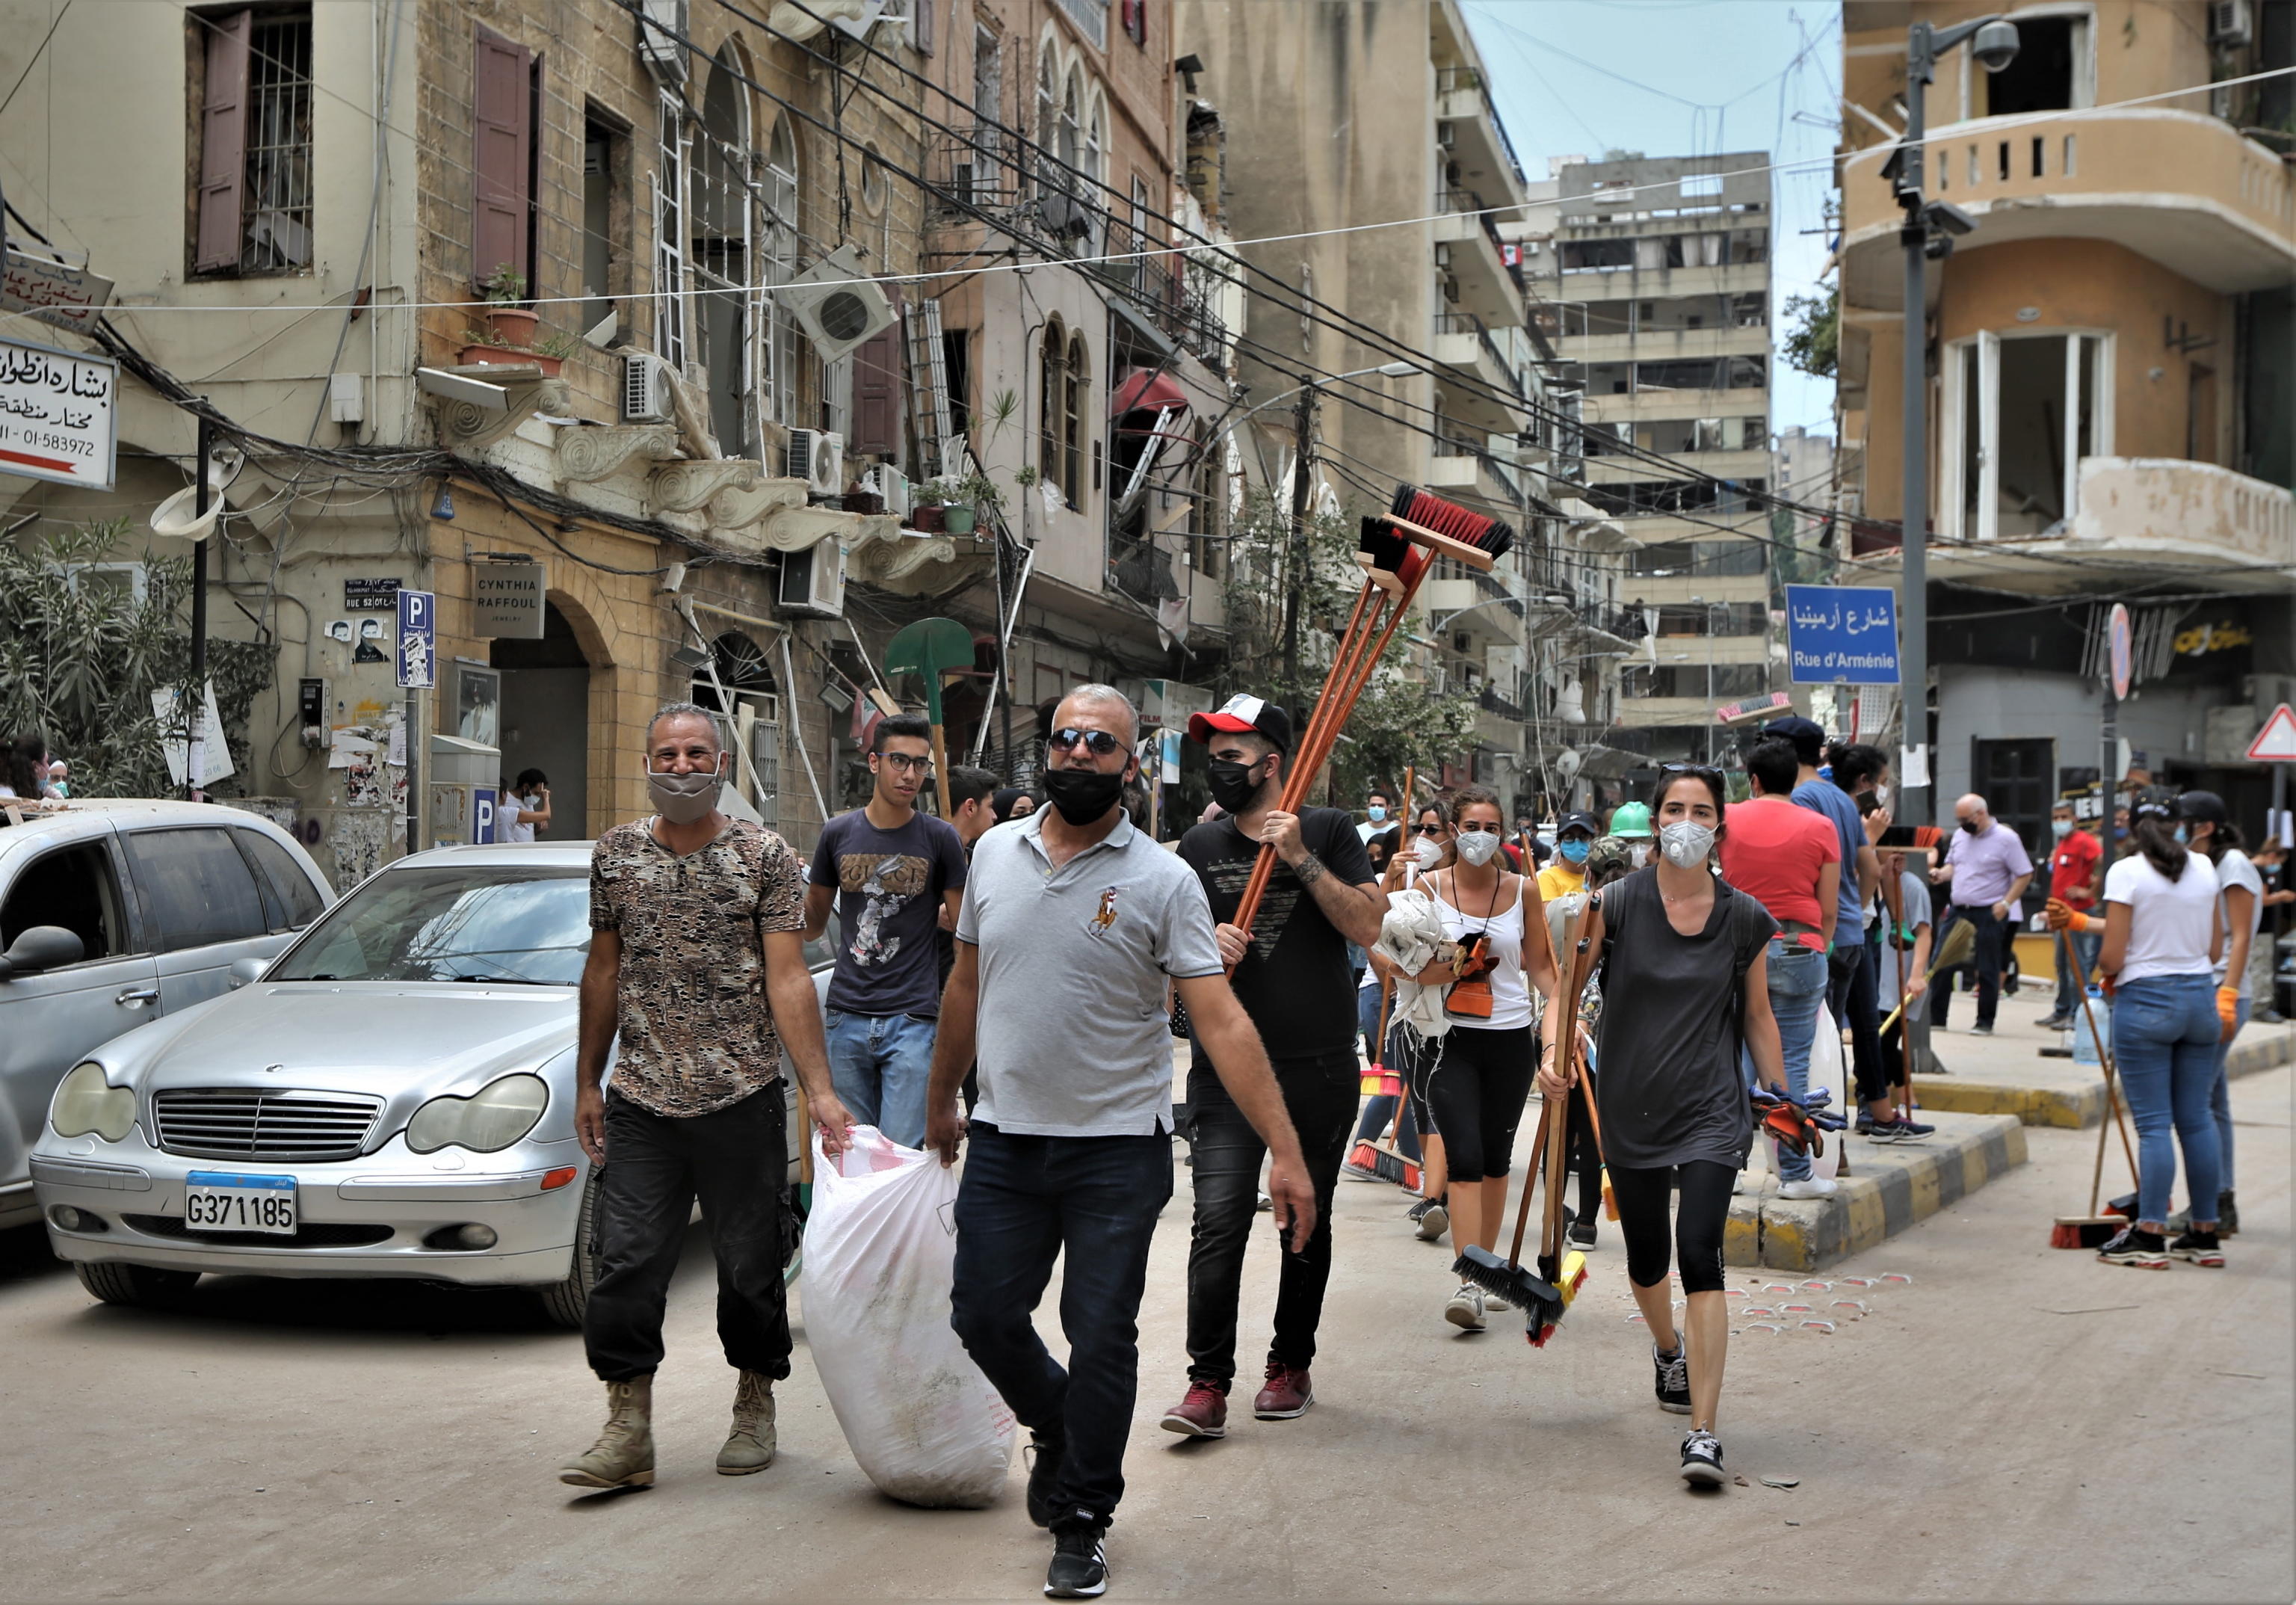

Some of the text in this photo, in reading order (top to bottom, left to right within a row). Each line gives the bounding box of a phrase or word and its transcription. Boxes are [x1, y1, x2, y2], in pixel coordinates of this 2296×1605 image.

[49, 407, 93, 429] مختار
[23, 429, 95, 457] 01-583972
[478, 579, 537, 591] CYNTHIA
[346, 598, 372, 608] RUE 52
[410, 597, 423, 624] P
[478, 598, 537, 609] RAFFOUL
[1793, 603, 1890, 635] شارع أرمينيا
[1794, 650, 1896, 669] Rue d'Arménie
[1139, 715, 1161, 723] FILM
[478, 799, 493, 845] P
[188, 1194, 292, 1227] G371185
